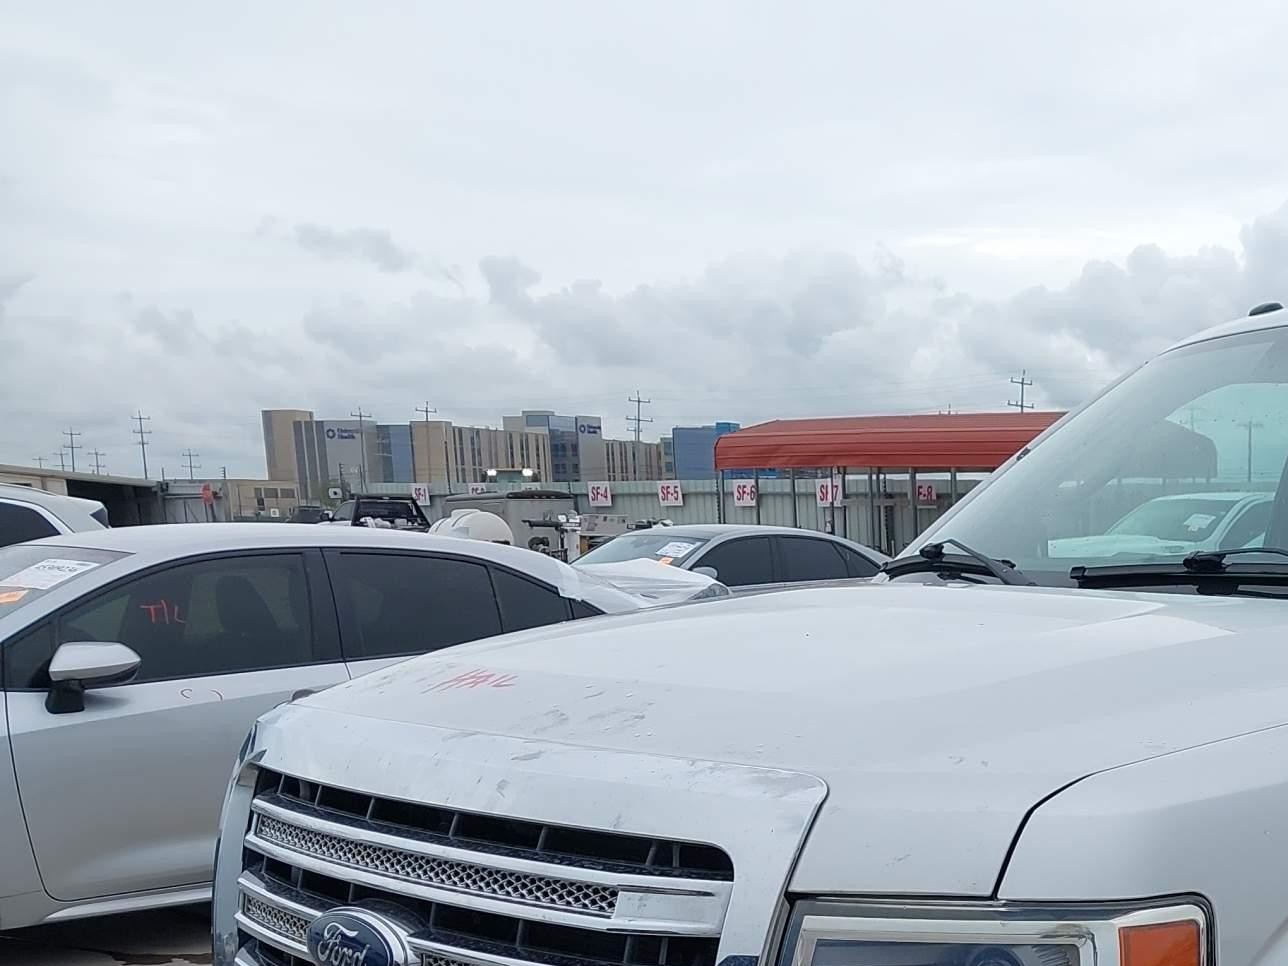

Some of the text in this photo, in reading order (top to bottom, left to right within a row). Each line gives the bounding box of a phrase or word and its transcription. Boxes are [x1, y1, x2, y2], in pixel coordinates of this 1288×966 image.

[591, 486, 608, 502] SF-4
[660, 485, 679, 501] SF-5
[736, 485, 756, 501] SF-6
